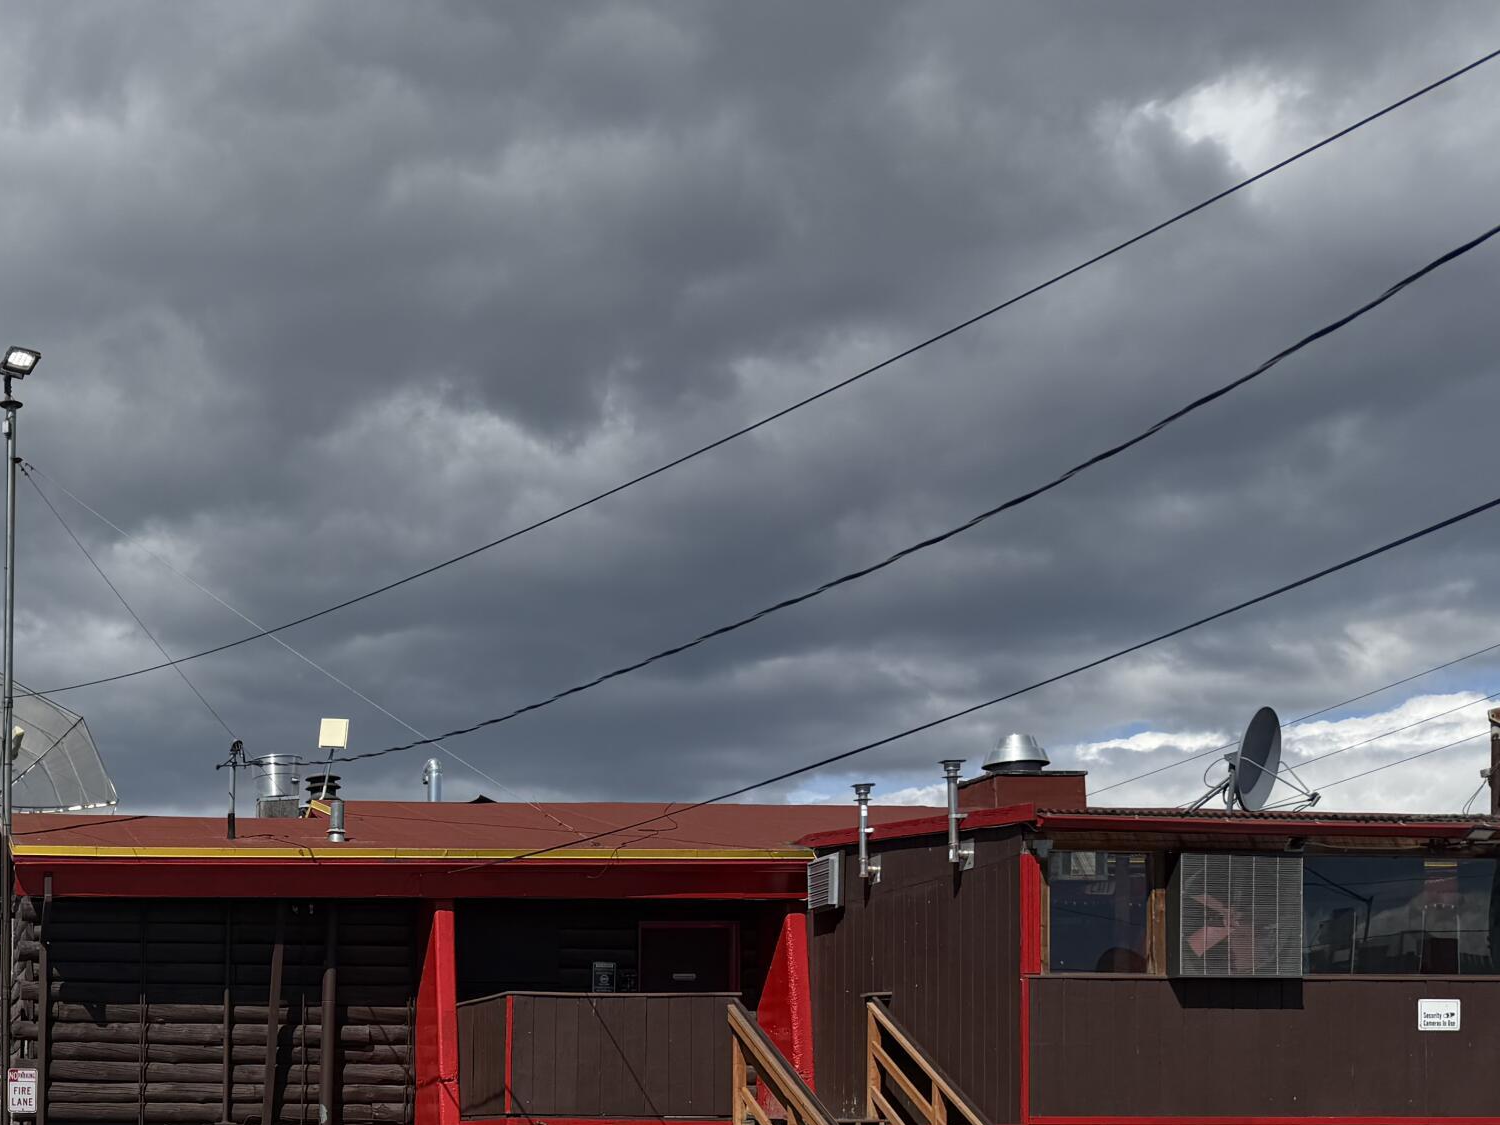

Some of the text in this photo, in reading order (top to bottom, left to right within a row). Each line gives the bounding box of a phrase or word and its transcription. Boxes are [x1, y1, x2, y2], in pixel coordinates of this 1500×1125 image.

[1423, 1012, 1442, 1020] Security
[9, 1071, 18, 1080] NO
[13, 1087, 32, 1095] FIRE
[11, 1098, 33, 1106] LANE
